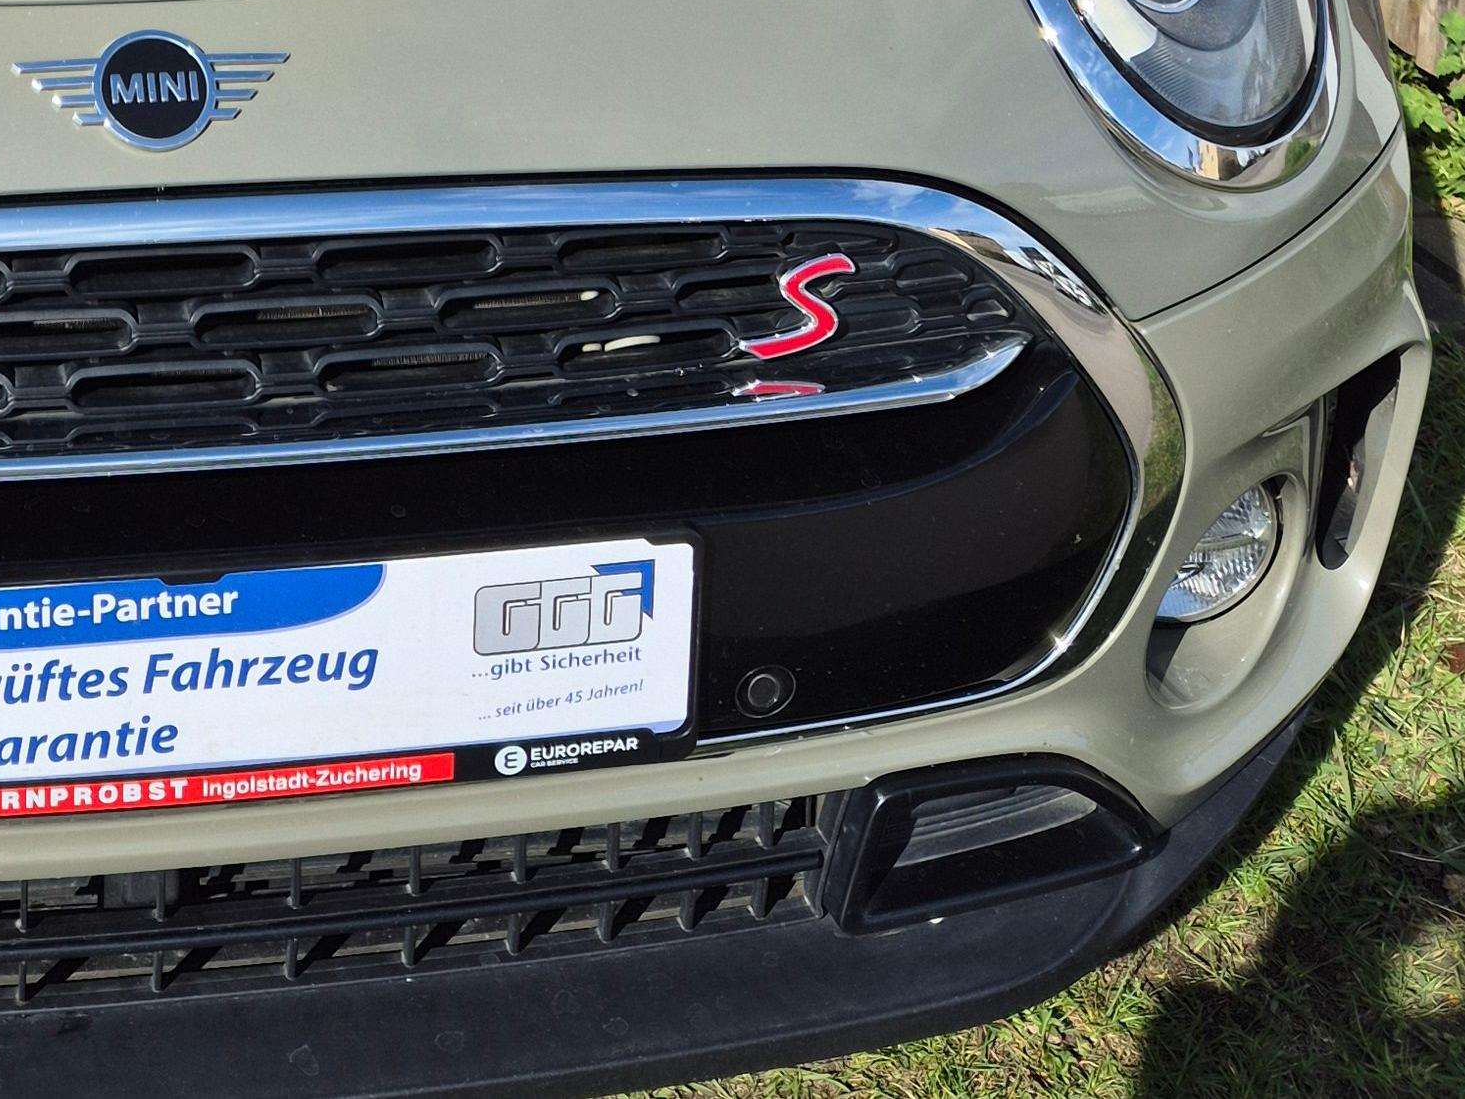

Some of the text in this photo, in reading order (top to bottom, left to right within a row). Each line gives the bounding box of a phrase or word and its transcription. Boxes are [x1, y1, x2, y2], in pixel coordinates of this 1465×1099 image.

[109, 70, 200, 105] MINI
[738, 252, 857, 361] S
[142, 647, 379, 695] Fahrzeug
[539, 646, 643, 671] Sicherheit
[495, 703, 522, 718] seit
[526, 696, 561, 712] über
[564, 690, 583, 704] 45
[587, 678, 644, 701] Jahren!
[530, 736, 640, 761] EUROREPAR
[530, 757, 579, 769] CAR SERVICE
[202, 761, 423, 799] Ingolstadt-Zuchering
